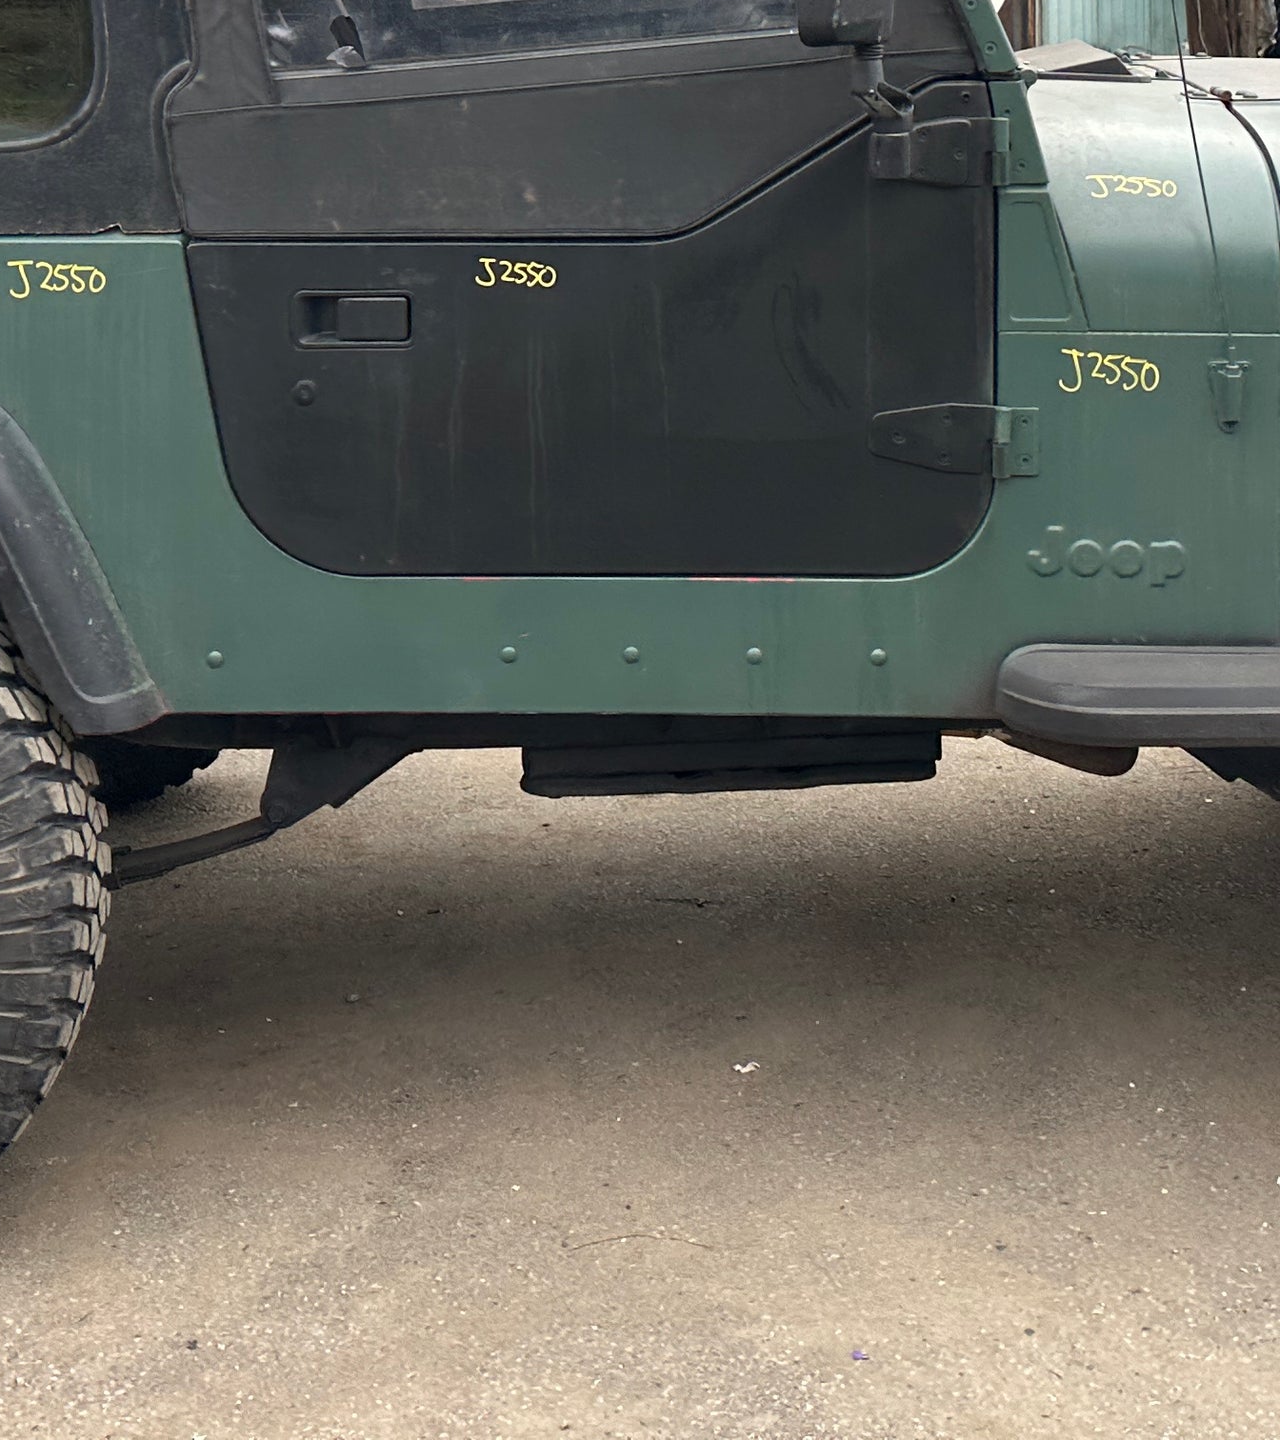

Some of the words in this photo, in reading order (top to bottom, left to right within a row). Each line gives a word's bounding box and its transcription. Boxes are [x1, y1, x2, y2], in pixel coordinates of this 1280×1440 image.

[1084, 174, 1178, 199] J2550
[6, 259, 107, 299] J2550
[474, 257, 558, 288] J2550
[1058, 348, 1161, 393] J2550
